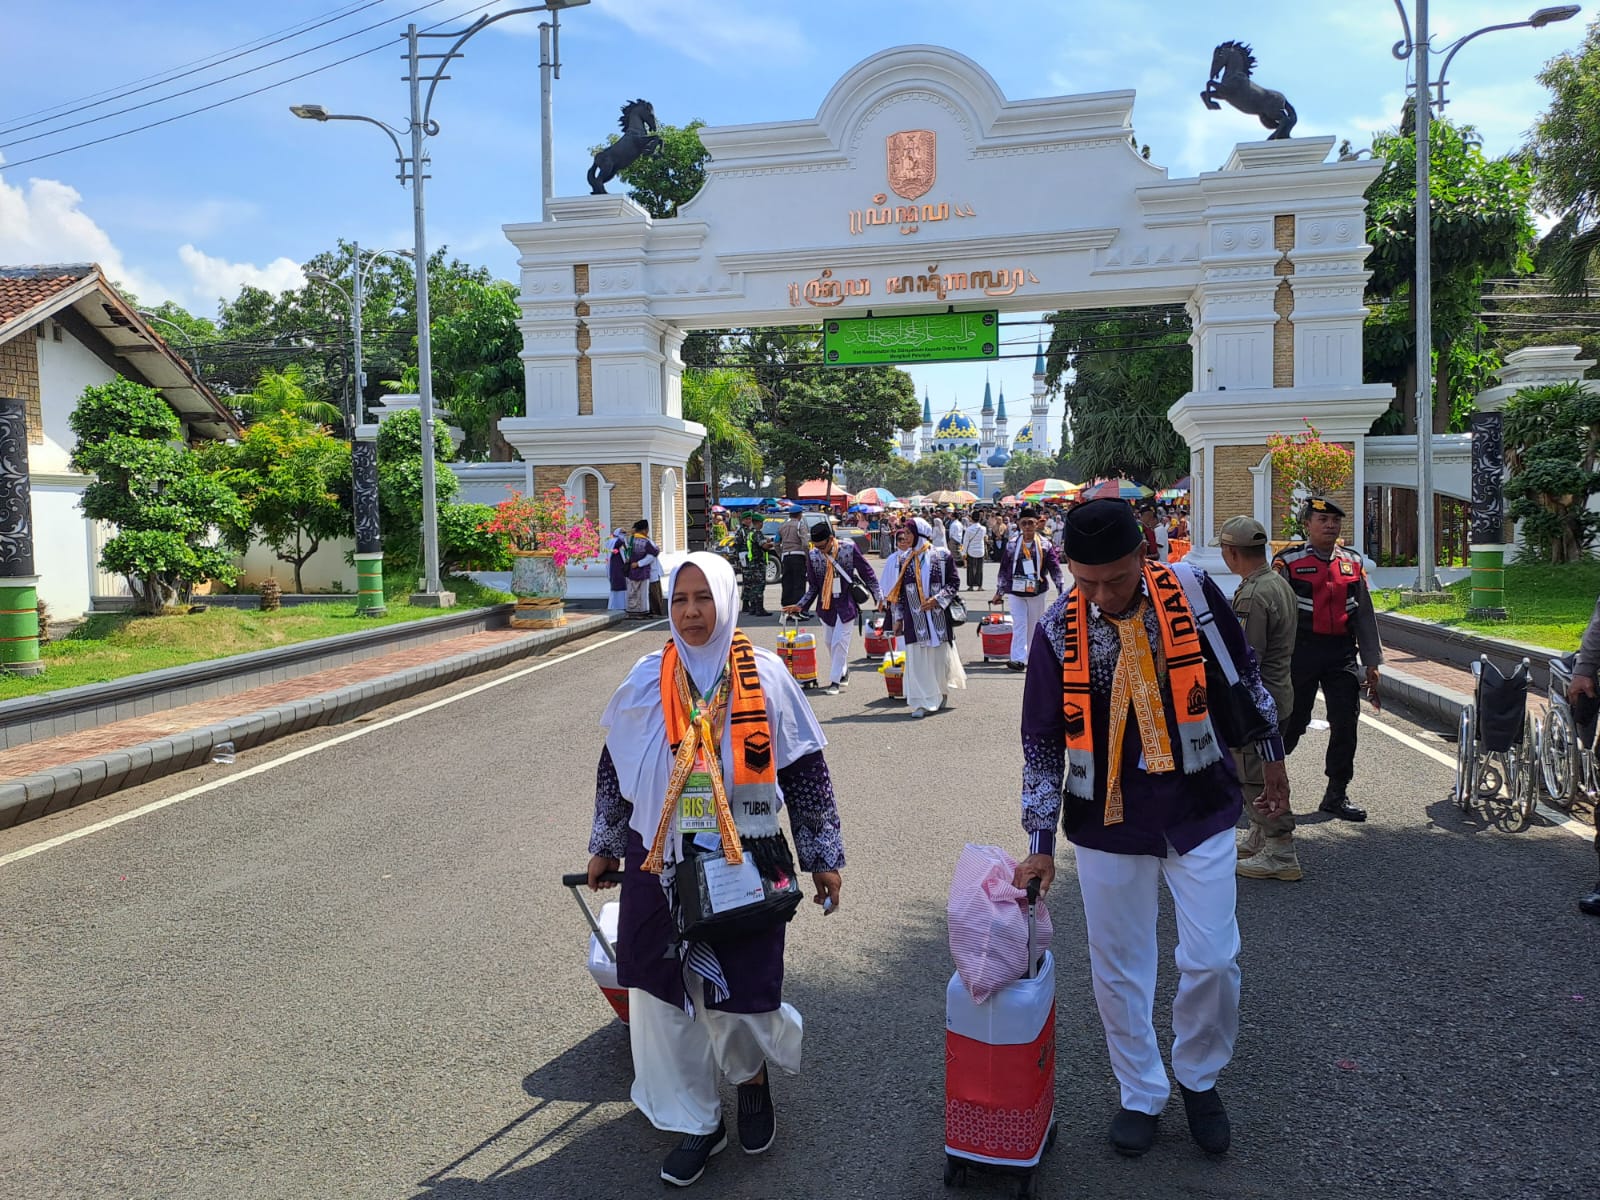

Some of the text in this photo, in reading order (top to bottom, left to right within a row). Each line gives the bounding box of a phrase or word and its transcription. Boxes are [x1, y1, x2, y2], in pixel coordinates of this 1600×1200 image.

[682, 797, 716, 818] BIS 4
[742, 801, 772, 816] TUBAN
